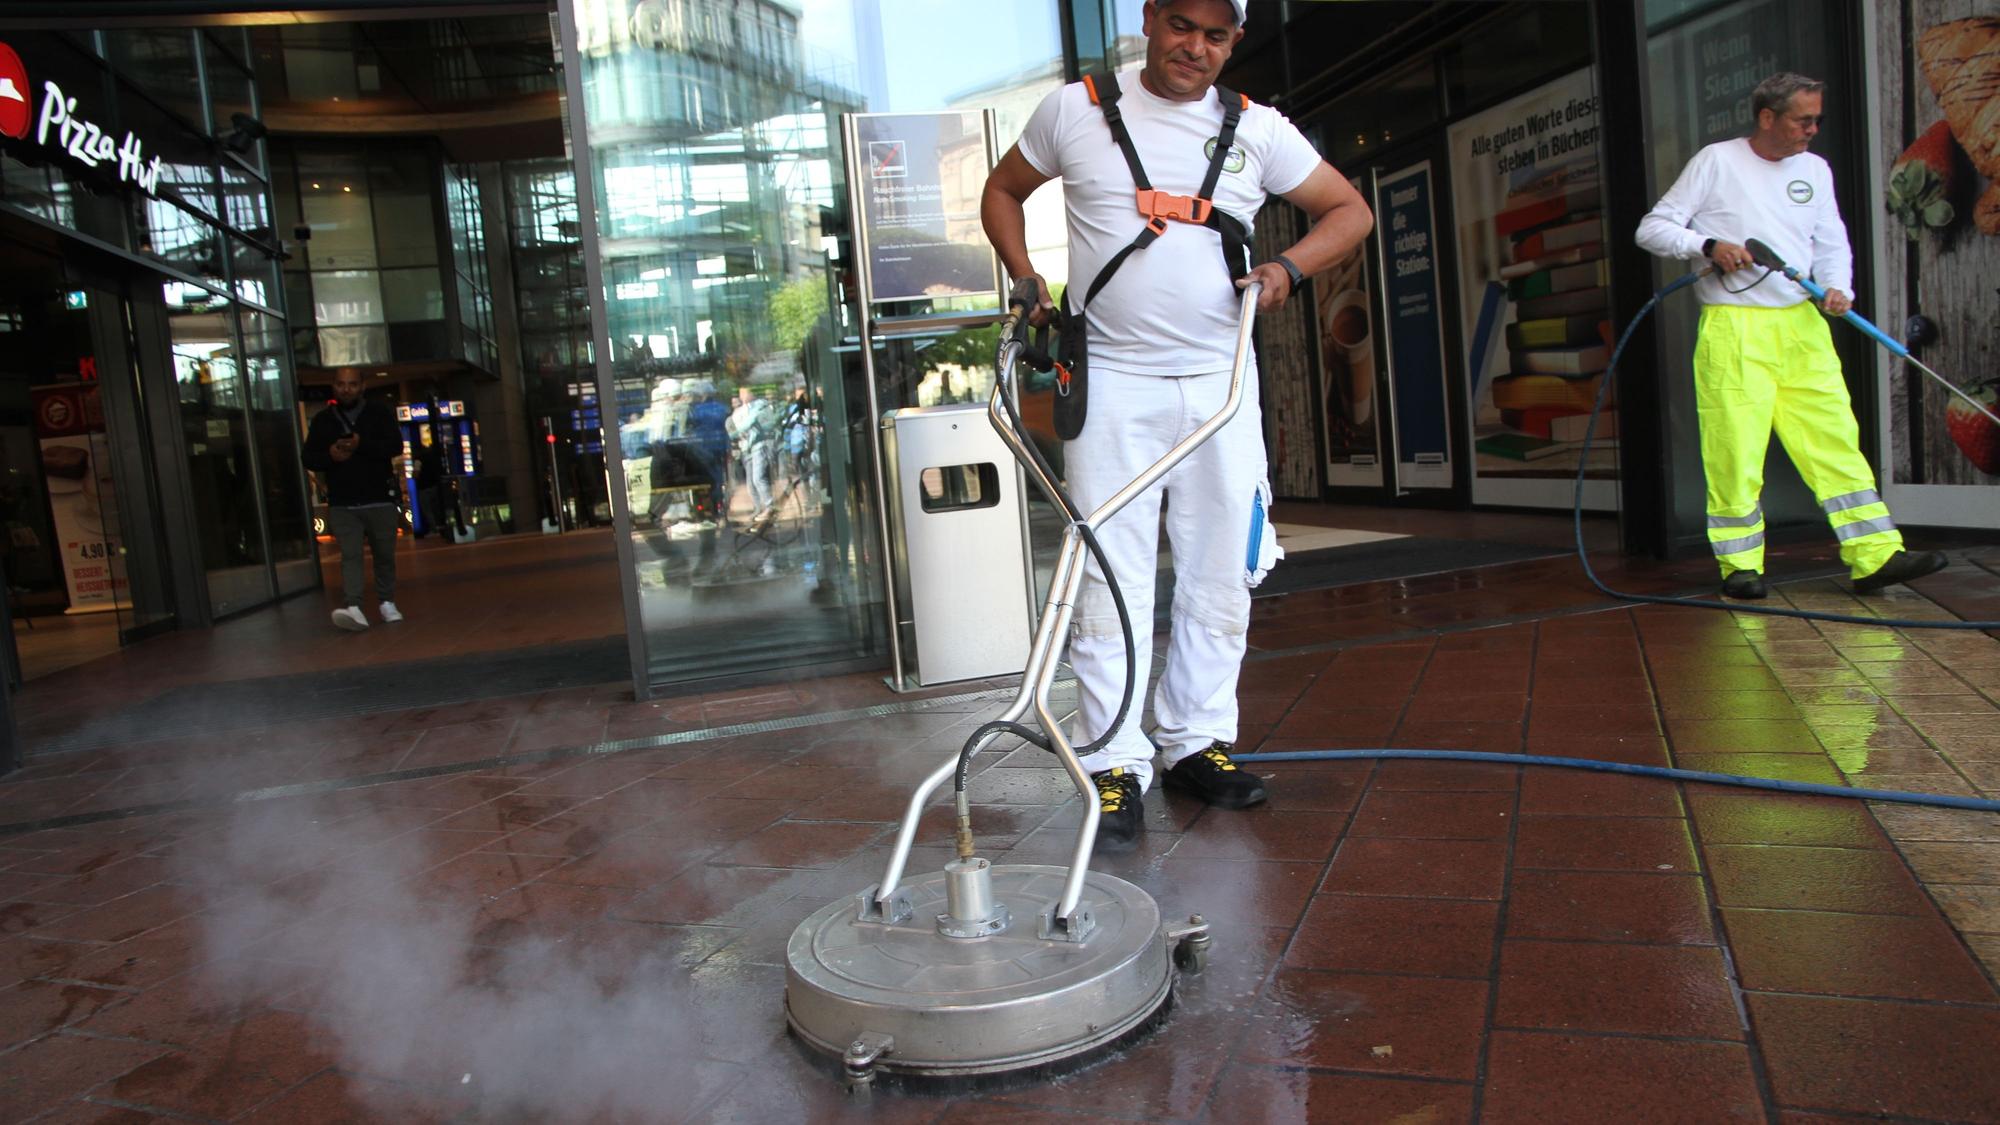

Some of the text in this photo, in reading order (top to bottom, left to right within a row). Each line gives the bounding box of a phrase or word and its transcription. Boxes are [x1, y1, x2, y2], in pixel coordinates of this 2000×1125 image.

[1703, 34, 1750, 67] Wenn
[1705, 53, 1778, 102] Sie nicht
[38, 80, 163, 196] Pizza Hut
[1471, 134, 1491, 158] Alle
[1493, 125, 1525, 155] guten
[1526, 108, 1563, 137] Worte
[1707, 109, 1732, 134] am
[1498, 147, 1536, 176] stehen
[1538, 141, 1549, 161] in
